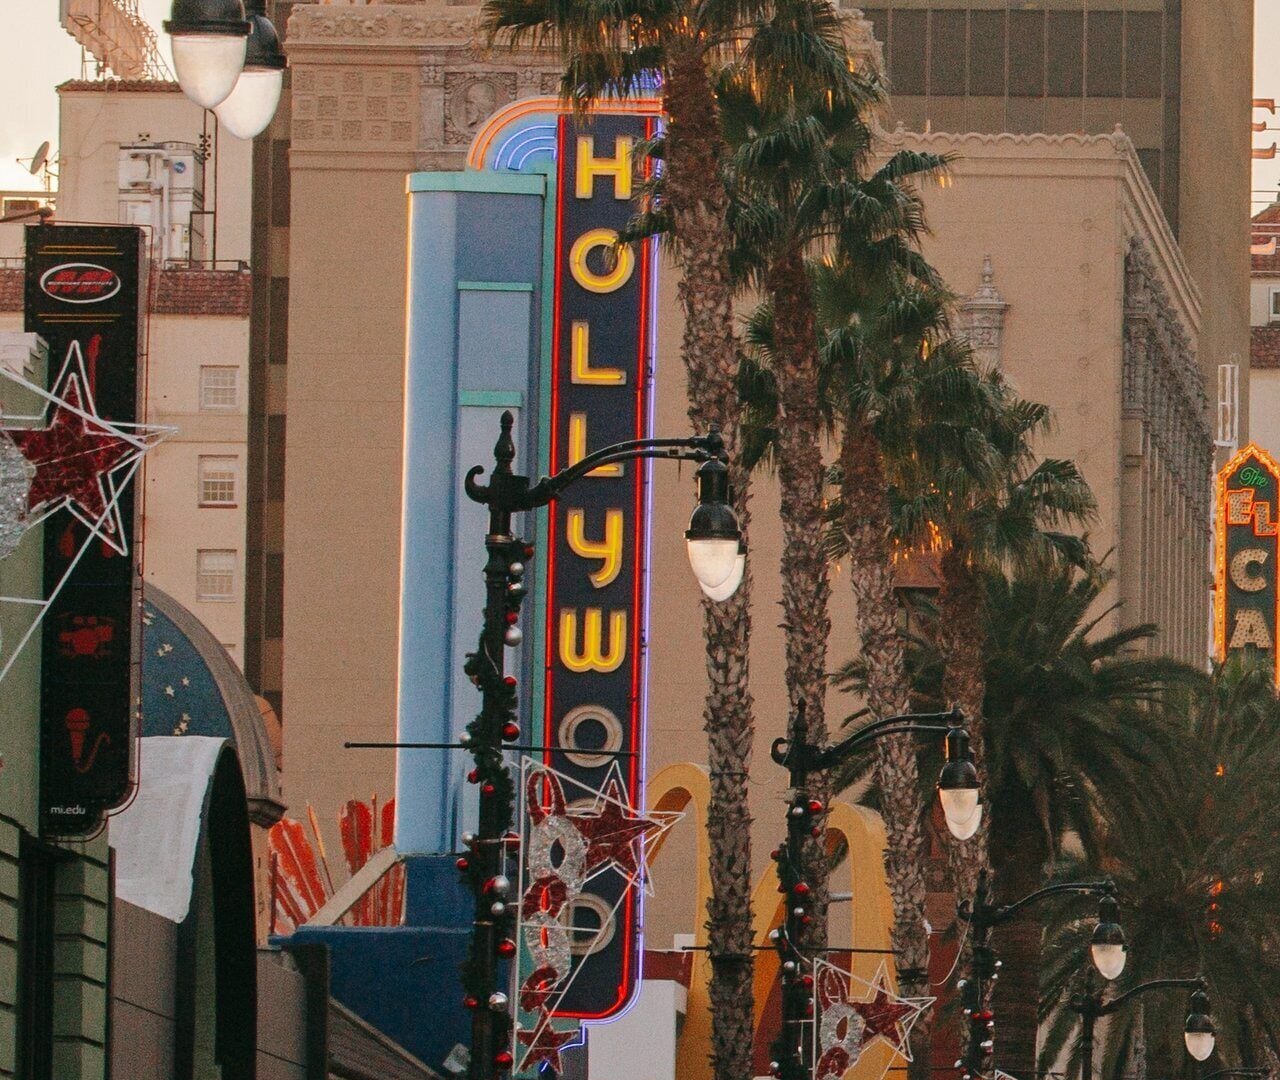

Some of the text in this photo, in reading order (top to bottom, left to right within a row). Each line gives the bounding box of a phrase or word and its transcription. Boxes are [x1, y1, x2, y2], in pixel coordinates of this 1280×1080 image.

[1239, 466, 1269, 488] The
[1227, 488, 1278, 536] EL
[558, 134, 636, 957] HOLLYWOD
[50, 804, 87, 815] mi.edu
